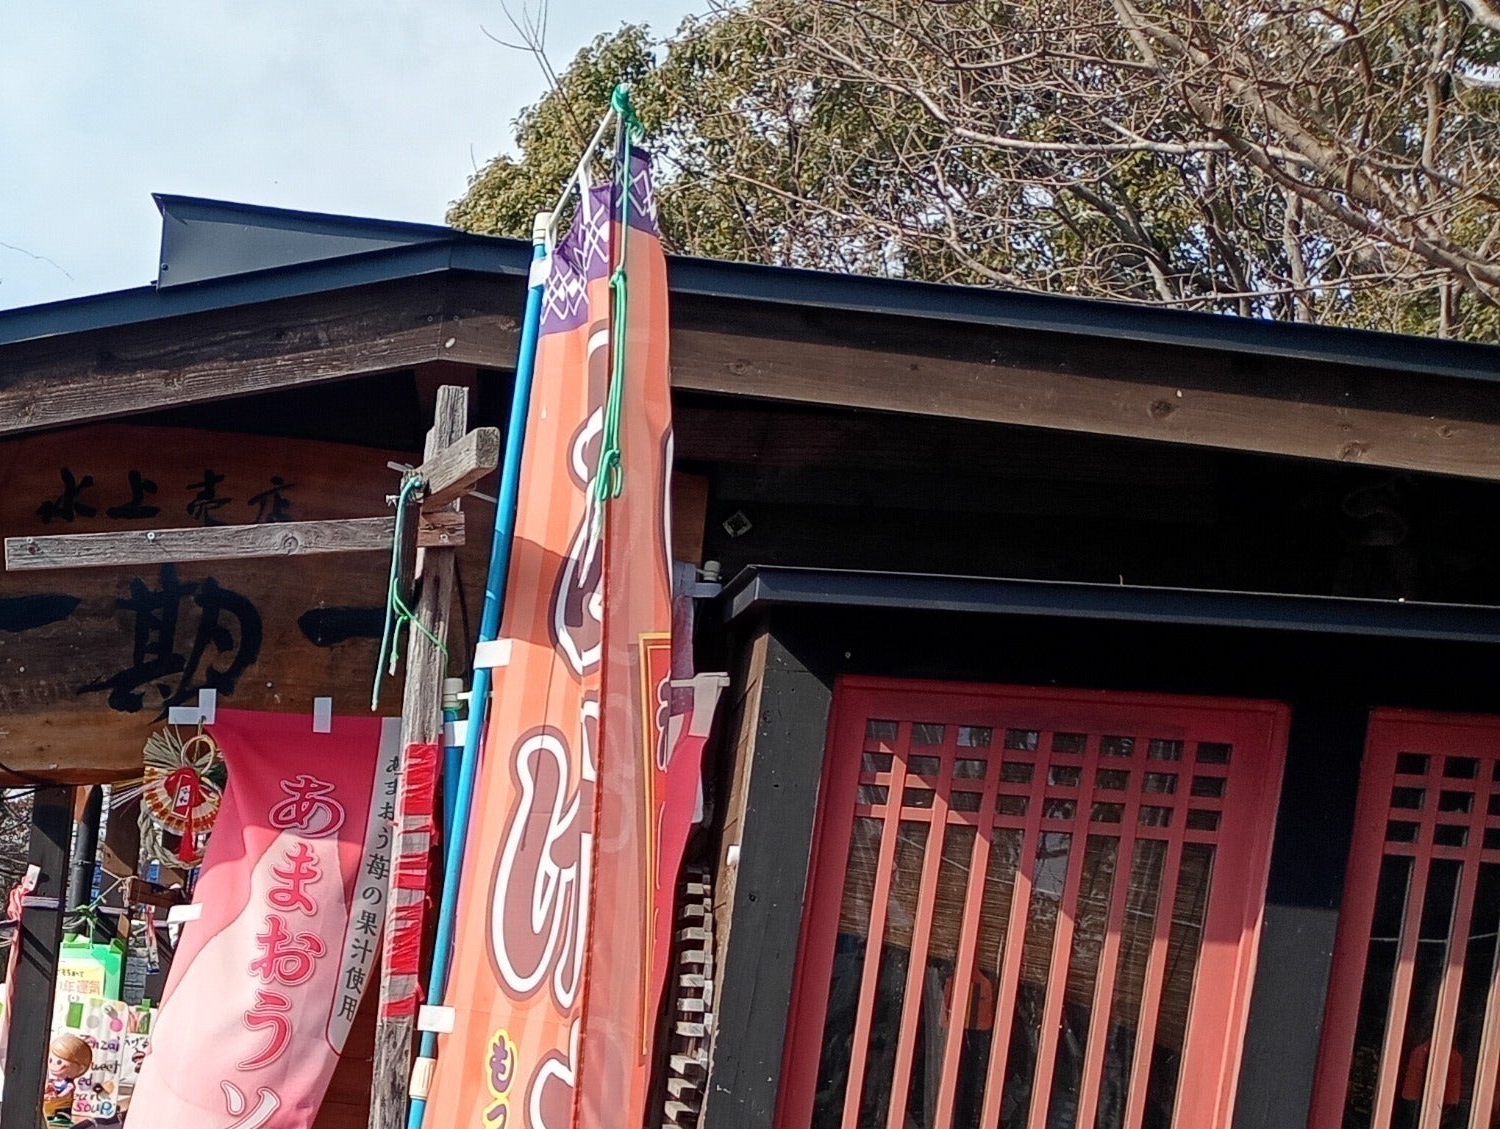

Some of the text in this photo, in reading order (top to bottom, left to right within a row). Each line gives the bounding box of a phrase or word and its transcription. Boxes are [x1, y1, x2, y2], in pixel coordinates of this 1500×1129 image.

[37, 467, 297, 523] 水上売店
[77, 1073, 93, 1086] ed
